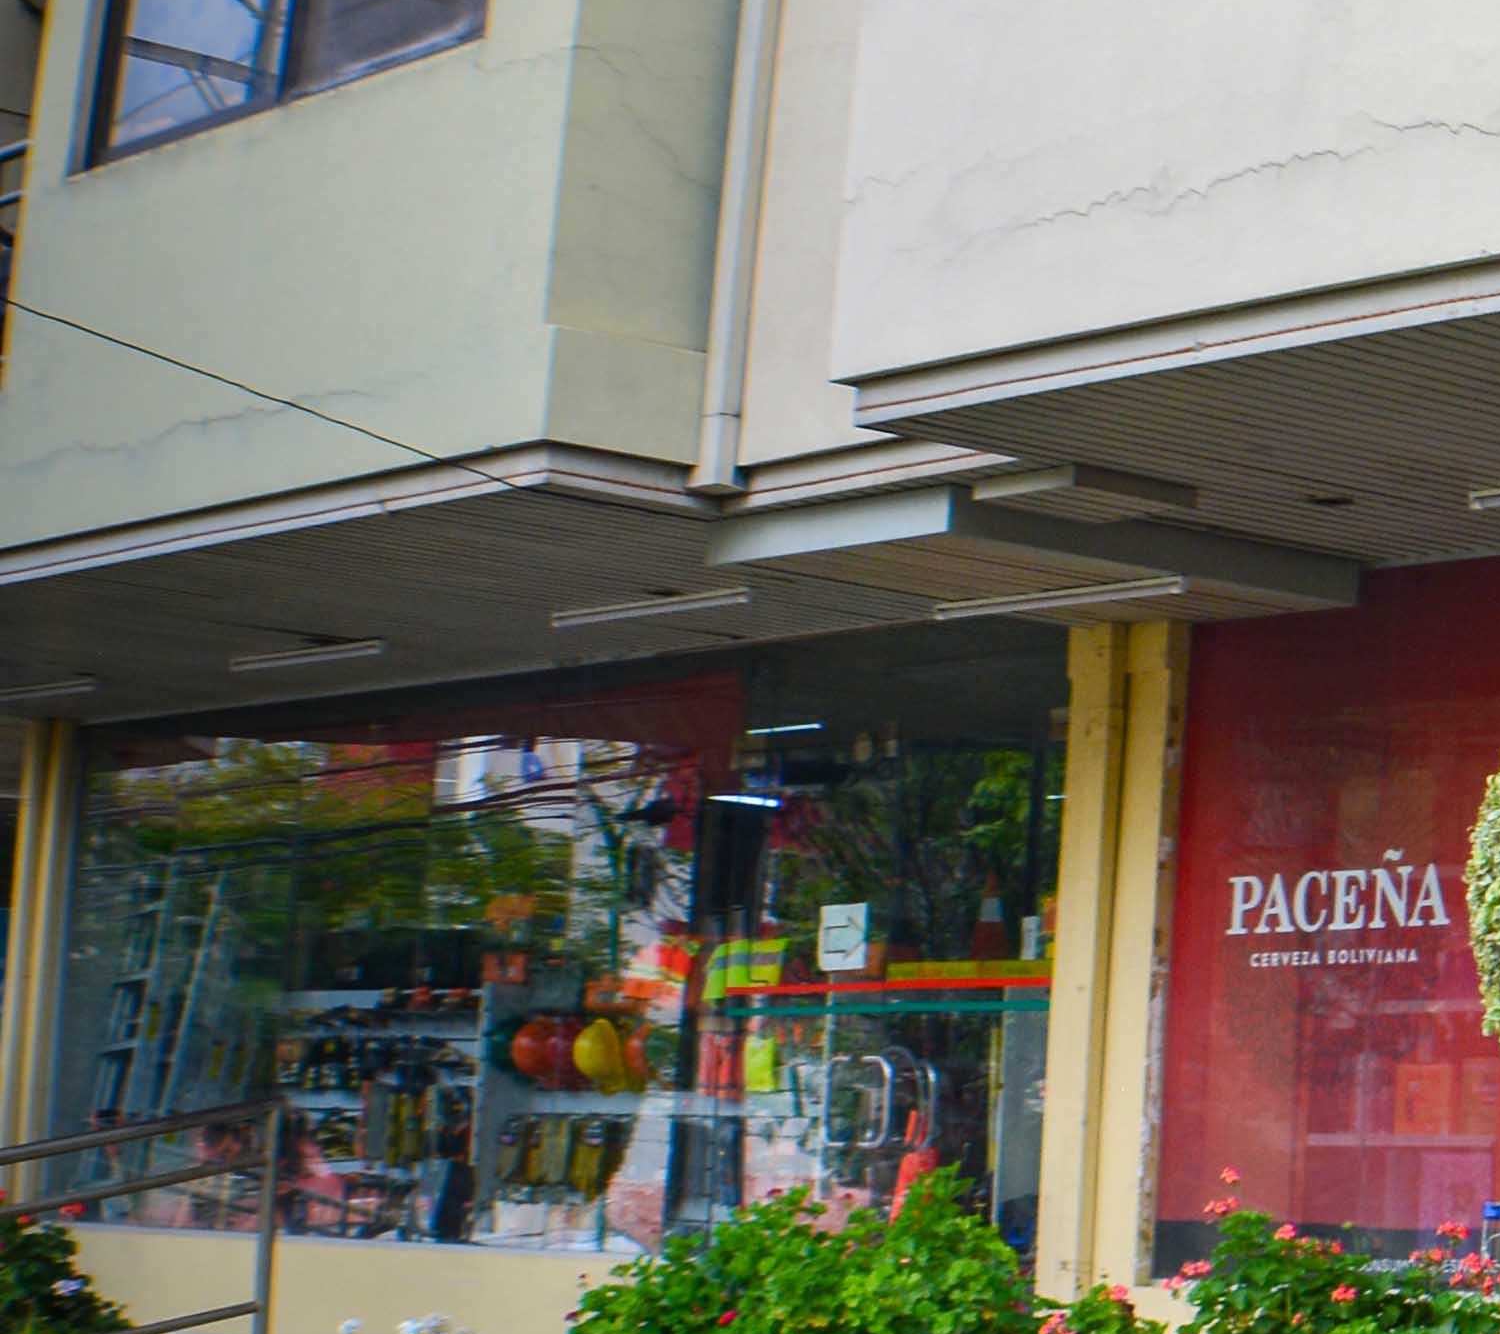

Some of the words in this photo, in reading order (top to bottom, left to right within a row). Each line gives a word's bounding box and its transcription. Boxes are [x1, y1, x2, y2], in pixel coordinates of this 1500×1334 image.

[1225, 848, 1451, 935] PACEÑA
[1250, 951, 1321, 968] CERVEZA
[1327, 947, 1420, 965] BOLIVIANA
